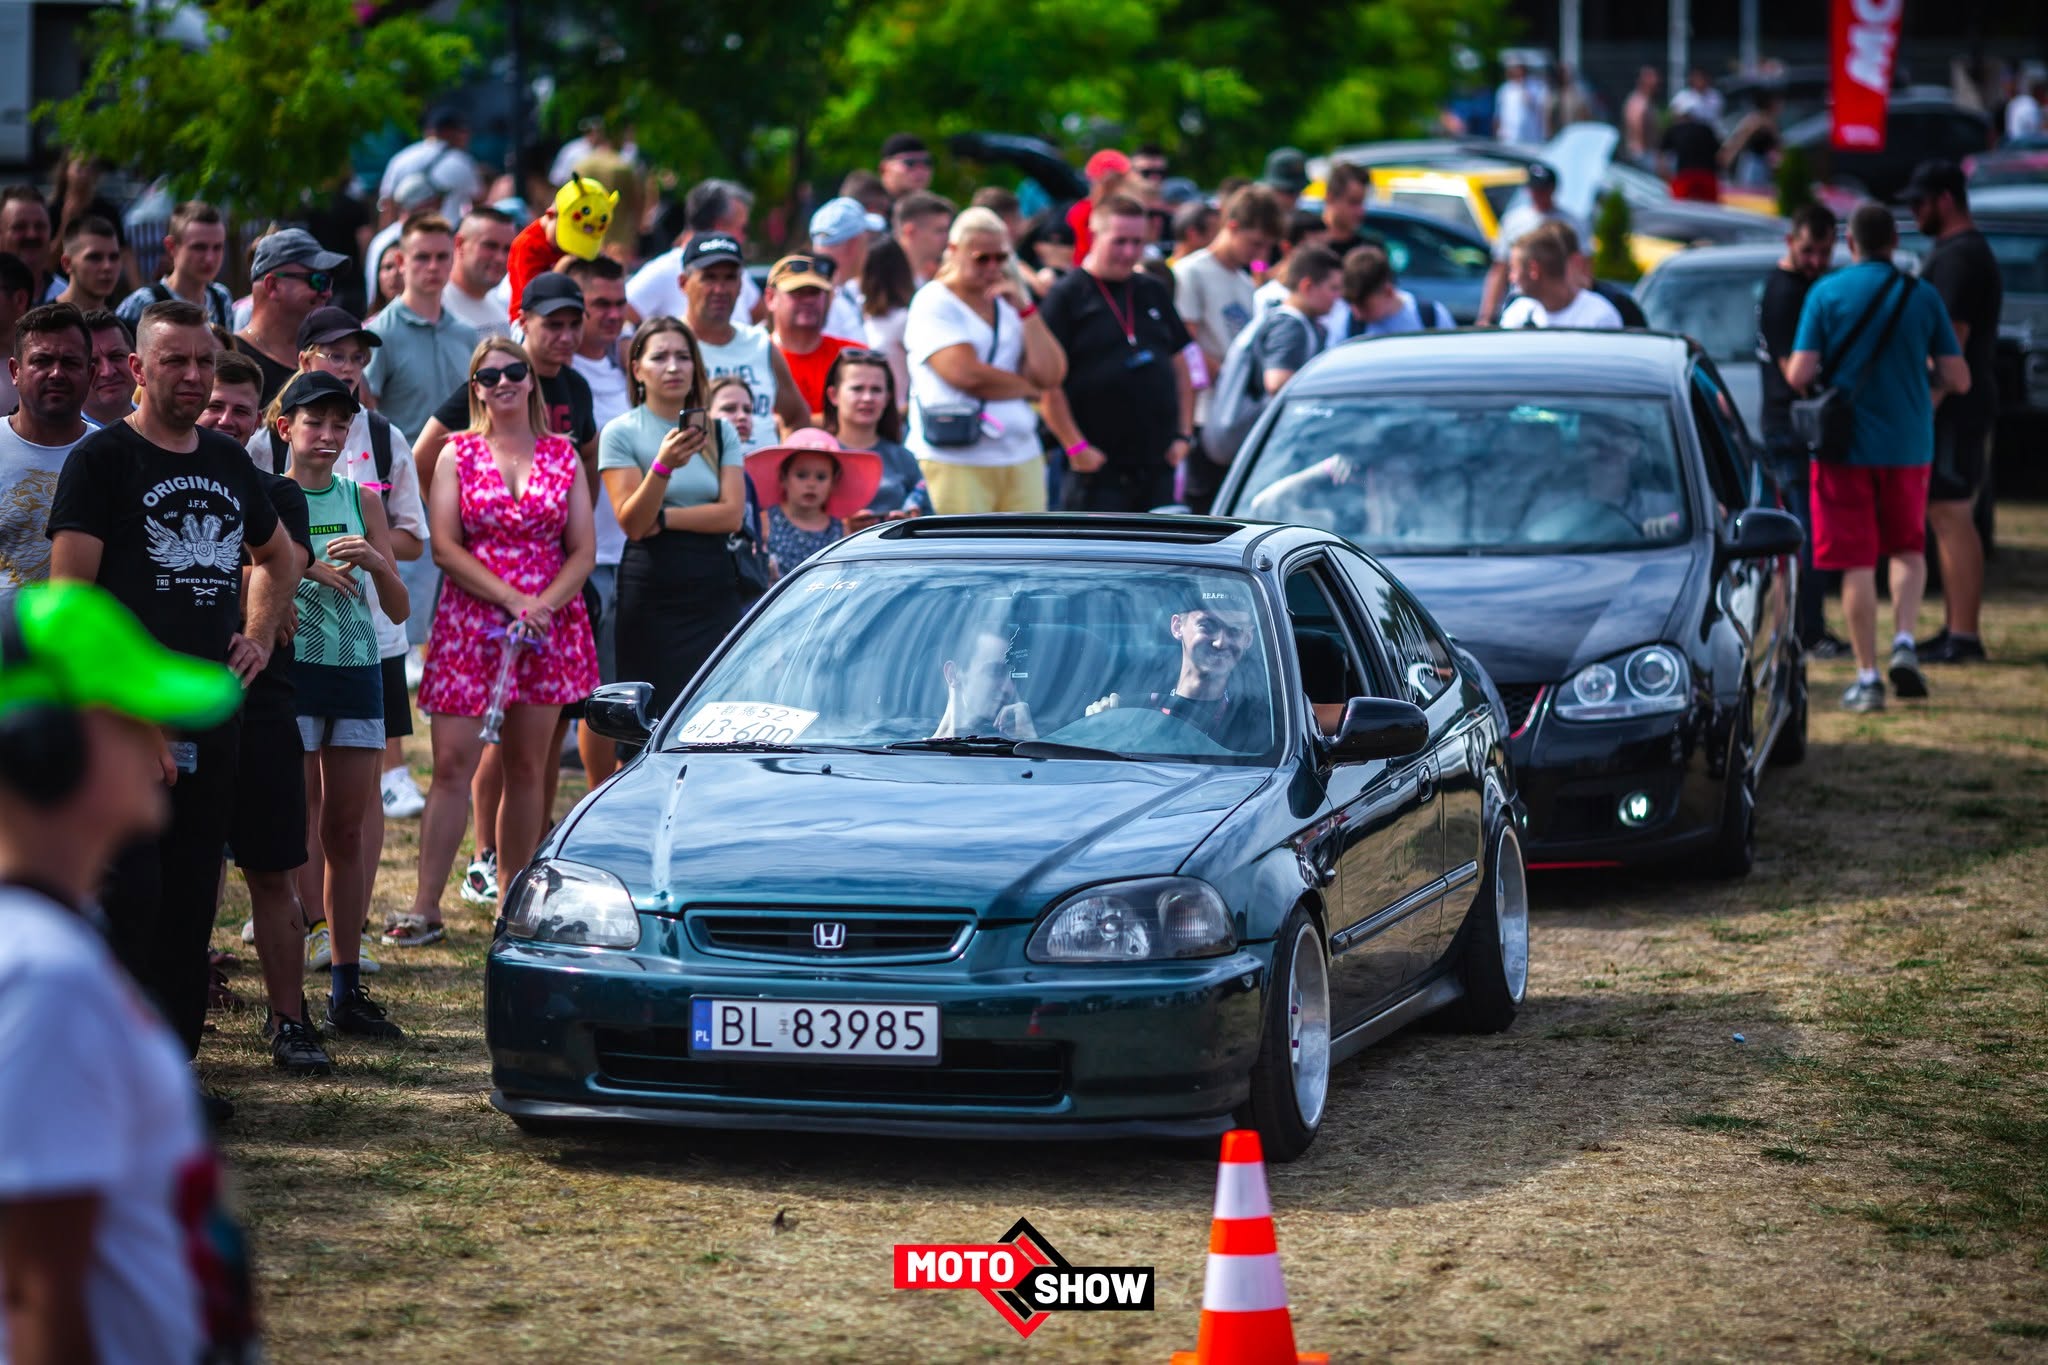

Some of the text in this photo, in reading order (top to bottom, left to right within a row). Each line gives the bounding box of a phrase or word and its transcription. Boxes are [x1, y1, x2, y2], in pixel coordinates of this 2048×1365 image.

[143, 476, 240, 511] ORIGINALS
[1202, 592, 1229, 600] REAPE
[757, 706, 790, 721] 52
[721, 1005, 925, 1051] BL 83985
[695, 1030, 709, 1042] PL
